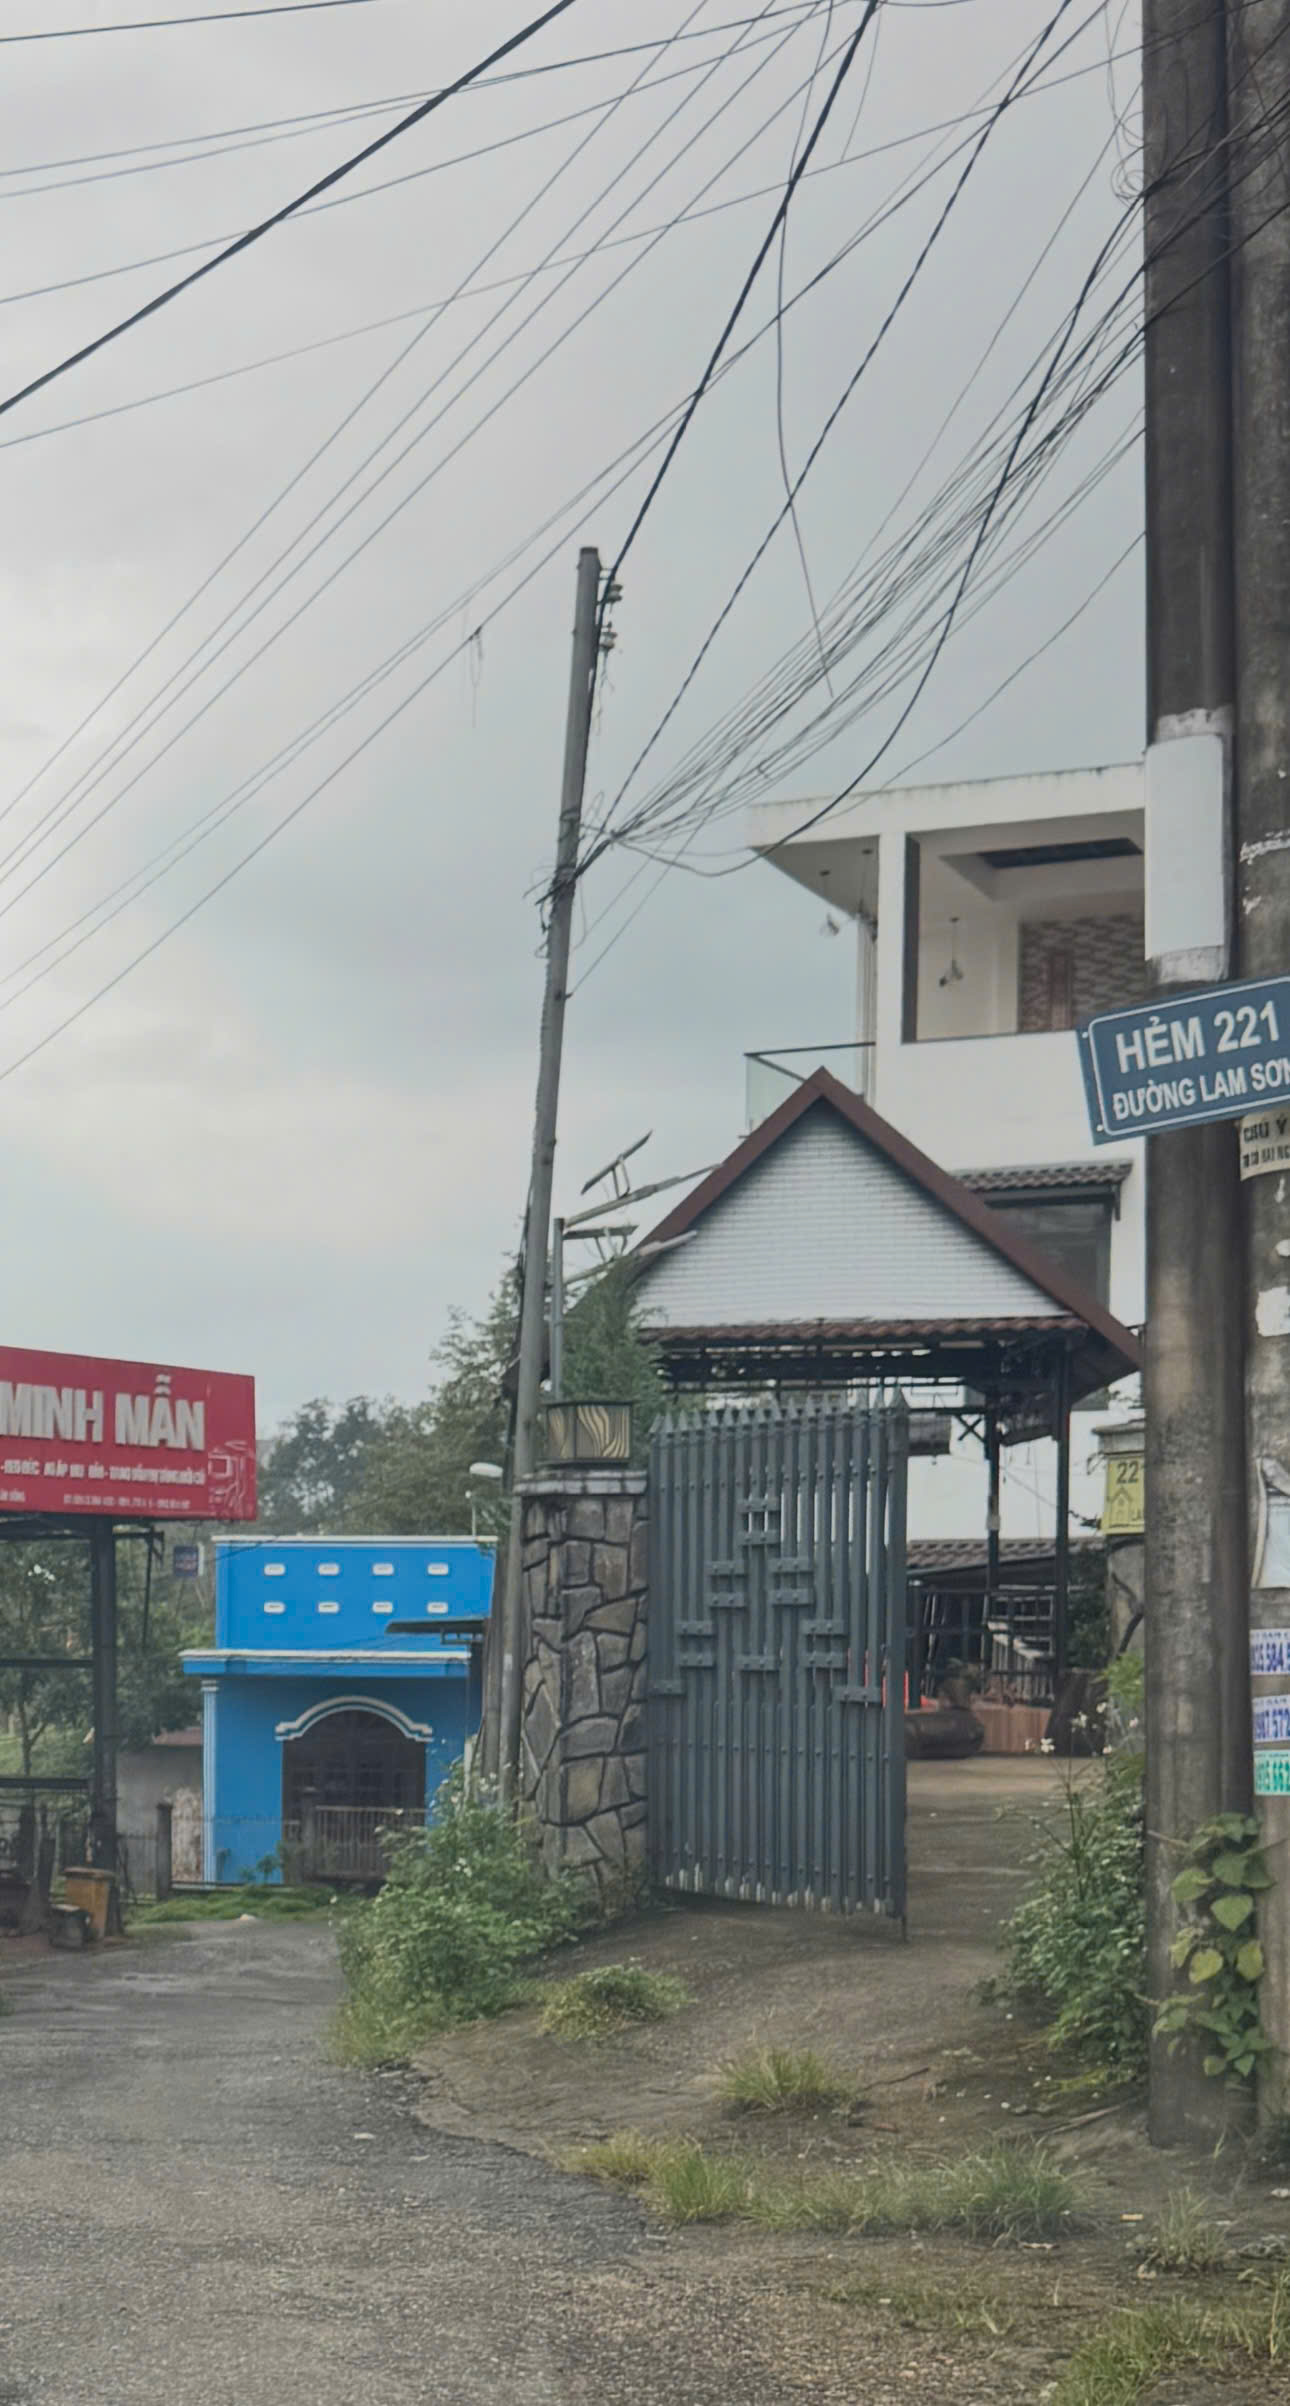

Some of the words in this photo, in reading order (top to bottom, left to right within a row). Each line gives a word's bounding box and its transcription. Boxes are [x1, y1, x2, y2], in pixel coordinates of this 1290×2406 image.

[1116, 1016, 1205, 1073] HẺM
[1214, 1000, 1279, 1053] 221
[1113, 1080, 1196, 1120] ĐƯỜNG
[1200, 1067, 1248, 1102] LAM
[0, 1380, 104, 1443] MINH
[115, 1374, 205, 1451] MẪN
